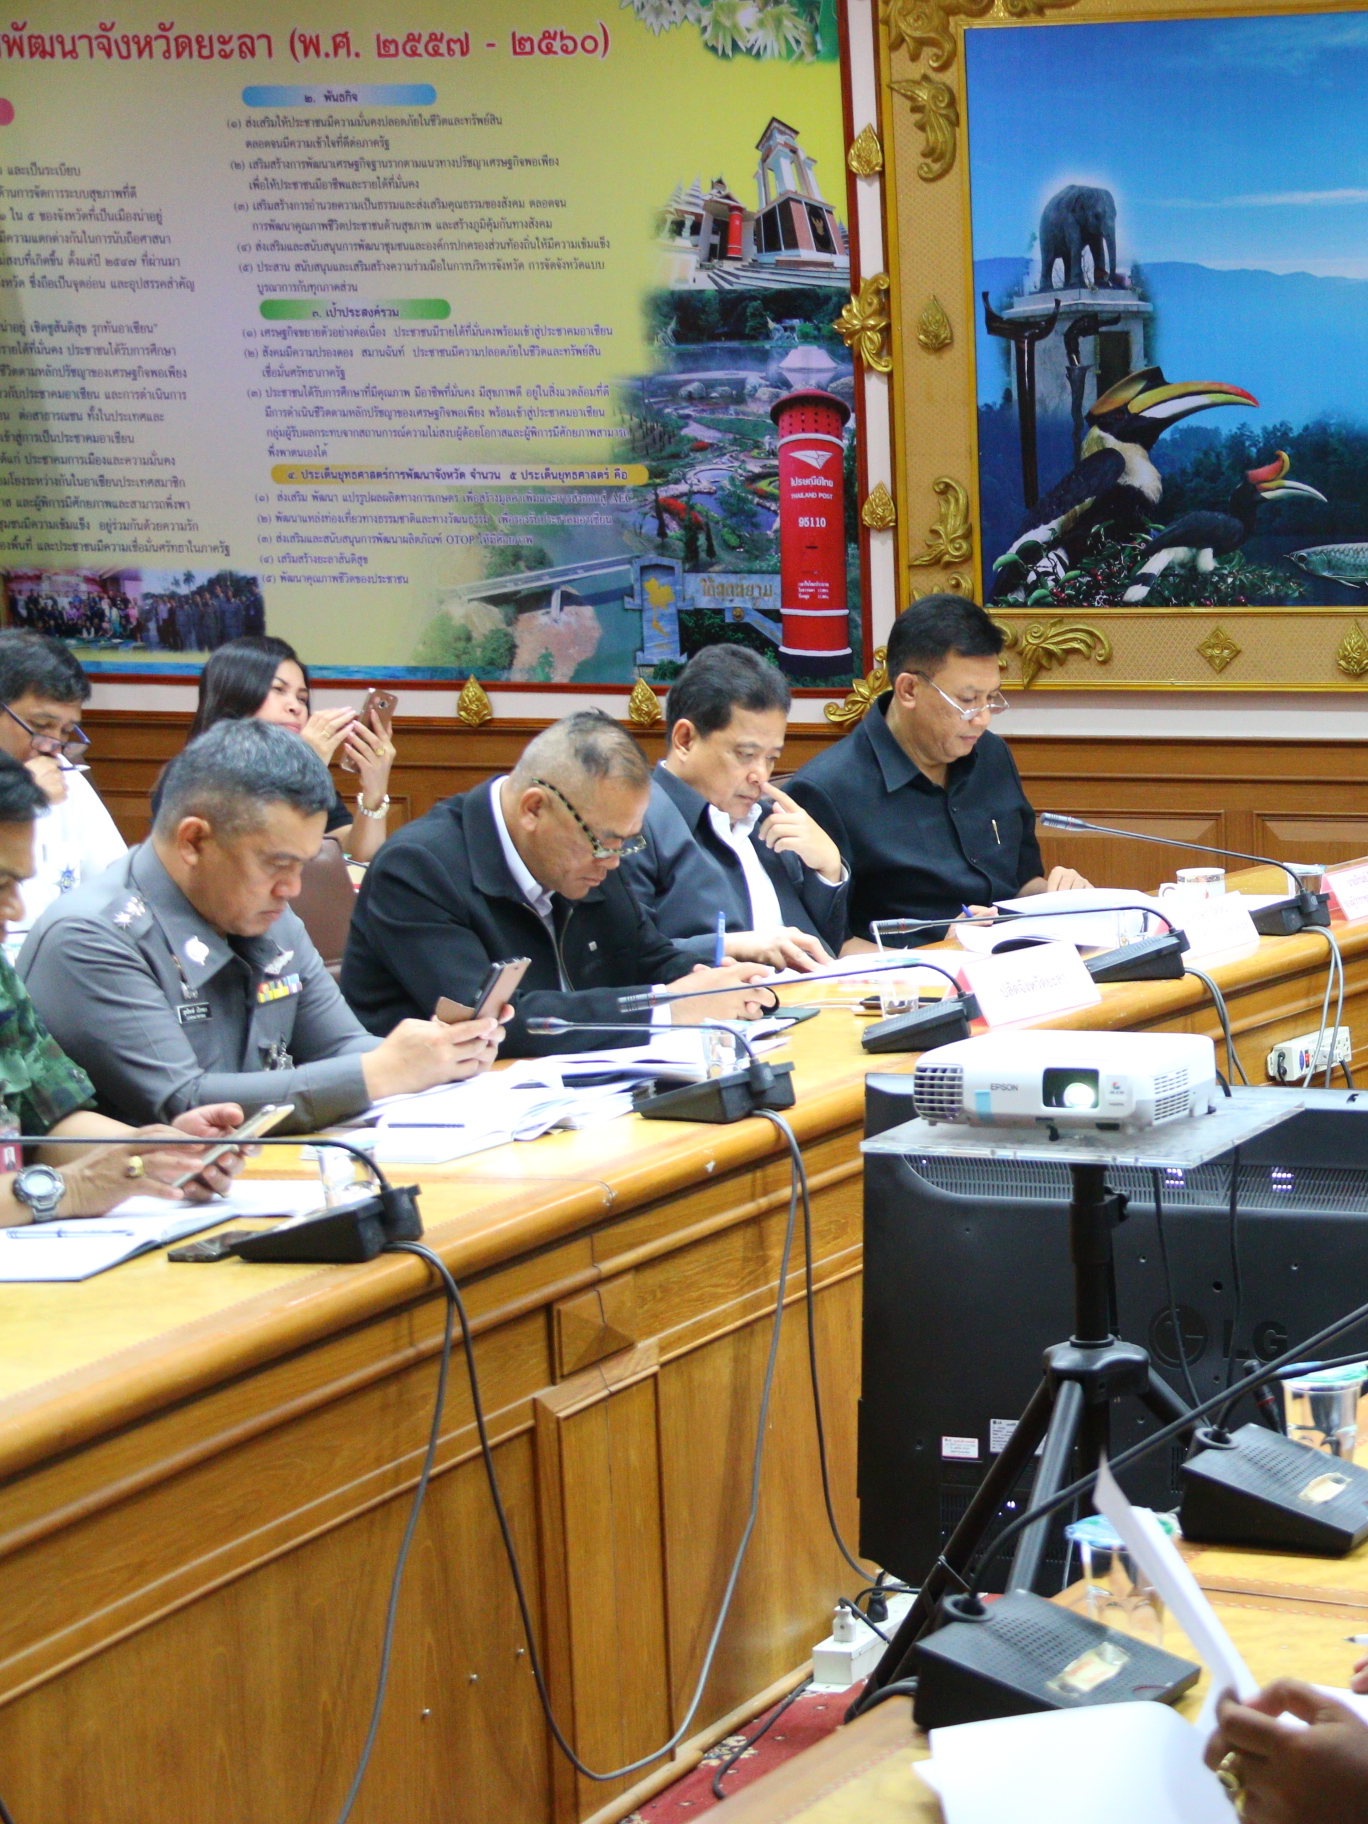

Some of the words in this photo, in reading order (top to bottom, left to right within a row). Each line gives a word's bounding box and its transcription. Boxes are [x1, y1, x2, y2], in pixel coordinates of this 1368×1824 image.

[1, 21, 273, 61] พัฒนาจังหวัดยะลา
[289, 27, 361, 63] (พ.ศ.
[376, 30, 470, 58] ๒๕๕๗
[511, 23, 610, 58] ๒๕๖๐)
[324, 90, 358, 103] พันธกิจ
[798, 517, 827, 528] 95110
[446, 534, 475, 545] OTOP
[990, 1083, 1019, 1091] EPSON
